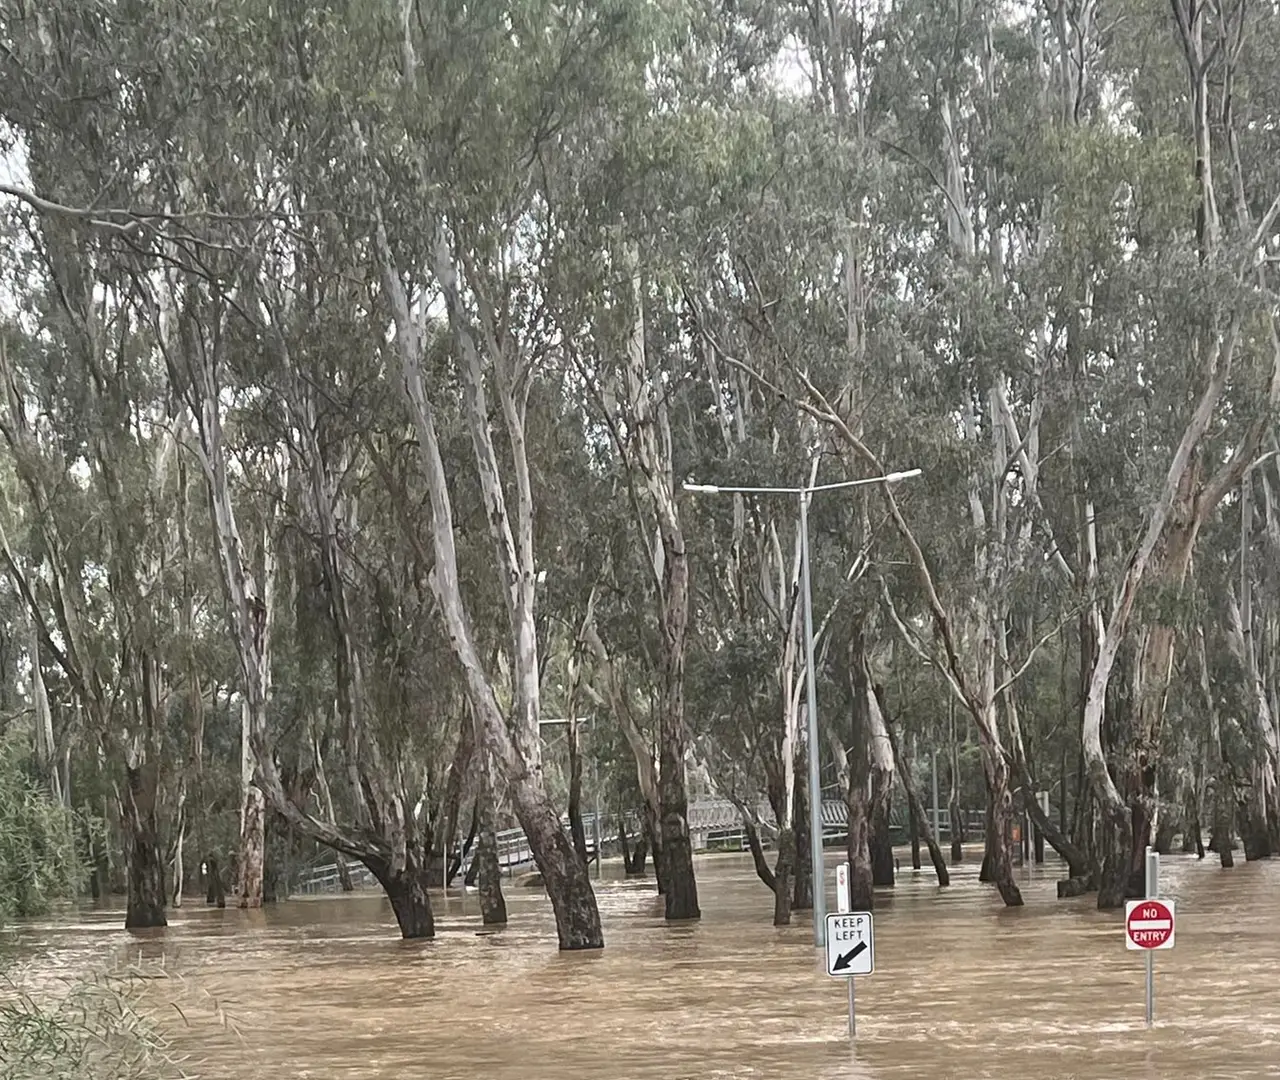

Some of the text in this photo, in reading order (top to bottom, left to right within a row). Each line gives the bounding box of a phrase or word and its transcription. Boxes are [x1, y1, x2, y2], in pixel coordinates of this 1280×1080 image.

[1143, 908, 1158, 919] NO
[834, 917, 863, 928] KEEP
[836, 930, 863, 941] LEFT
[1133, 931, 1167, 942] ENTRY
